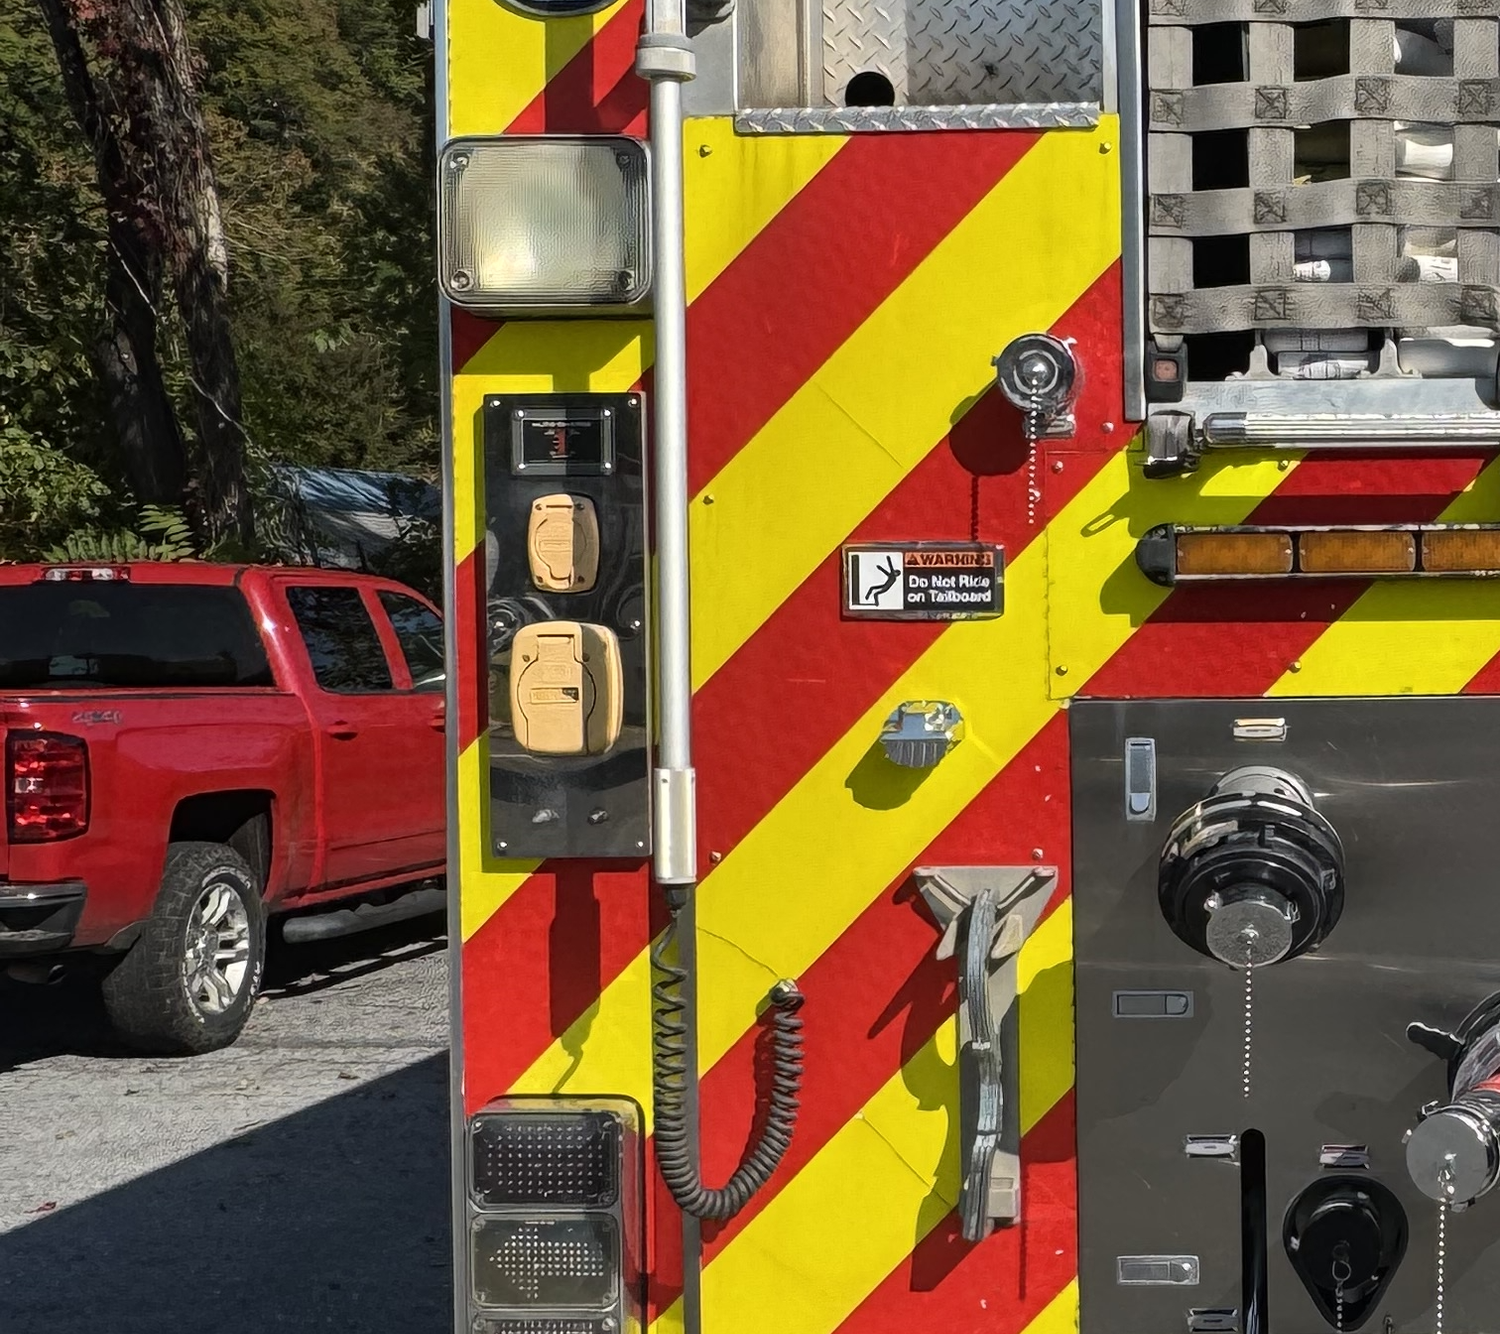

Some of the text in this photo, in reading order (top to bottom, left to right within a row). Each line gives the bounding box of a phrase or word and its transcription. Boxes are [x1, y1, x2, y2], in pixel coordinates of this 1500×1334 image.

[908, 575, 991, 588] Do Not Ride
[907, 589, 992, 603] on Tailboard
